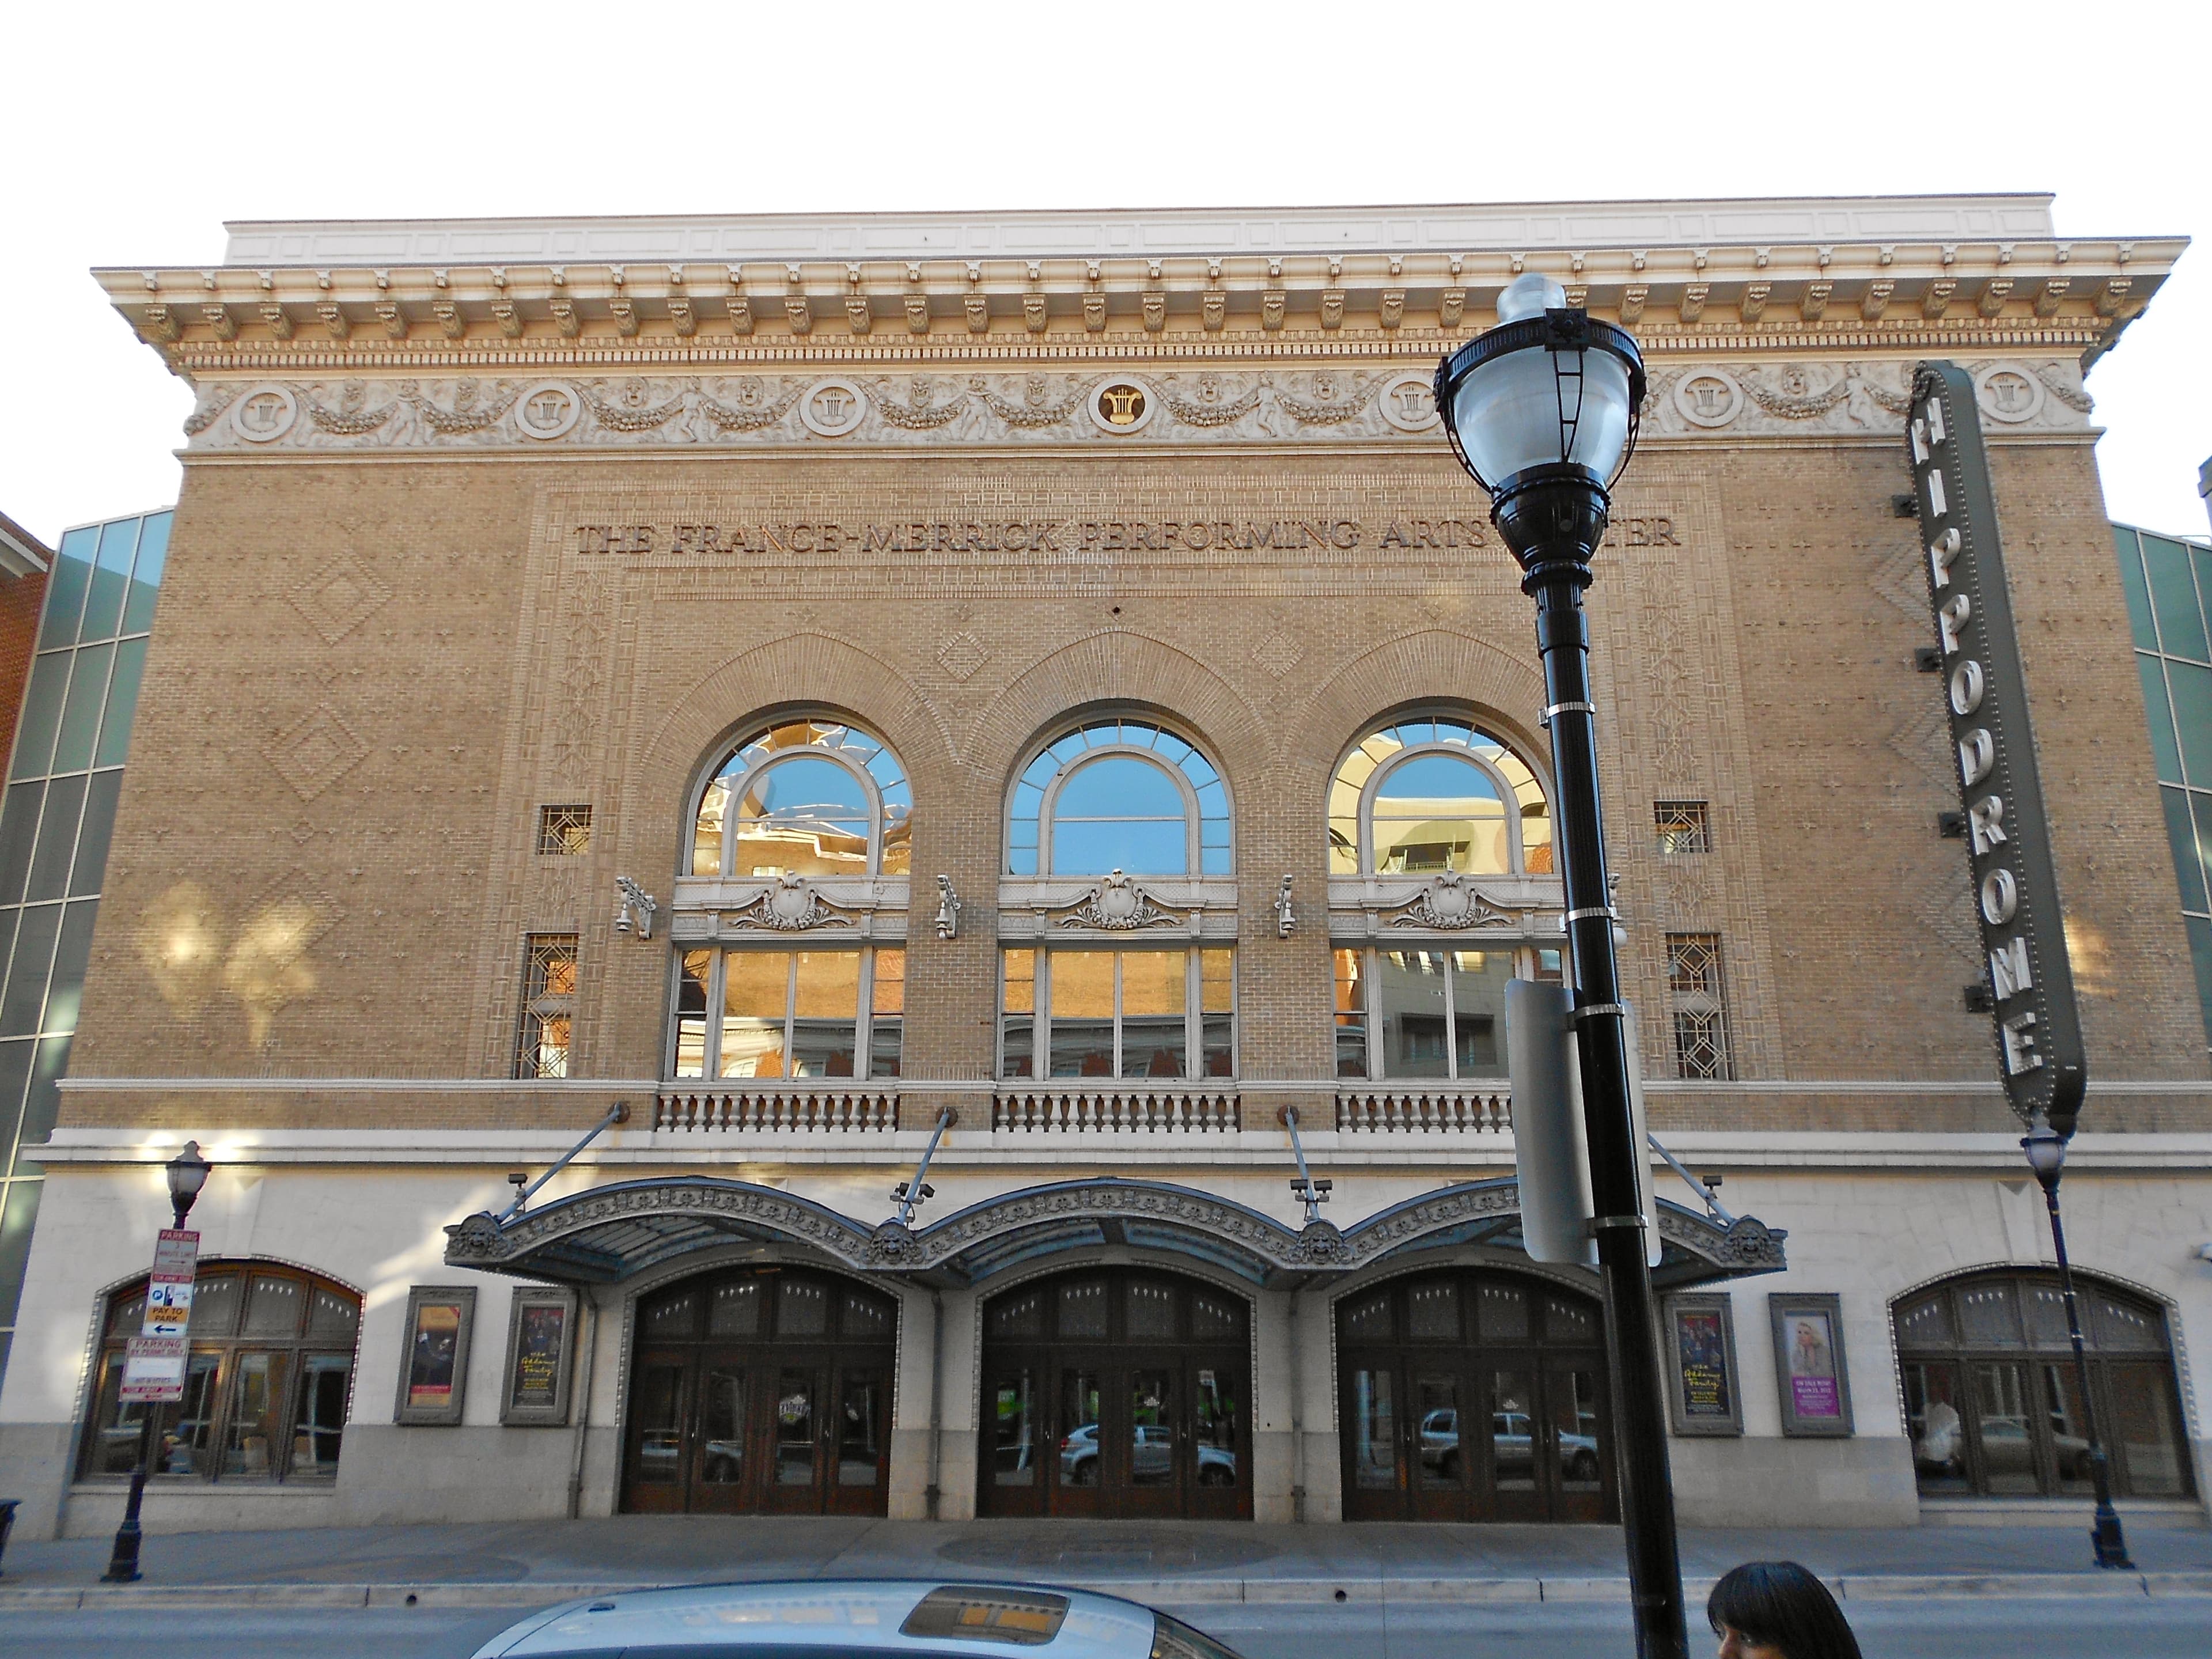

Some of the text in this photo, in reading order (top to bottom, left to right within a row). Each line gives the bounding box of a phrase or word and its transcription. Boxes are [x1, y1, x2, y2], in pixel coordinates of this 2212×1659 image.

[575, 518, 1681, 554] THE FRANCE-MERRICK PERFORMING ARTS TER
[1910, 397, 2043, 1076] HIPPODROME
[161, 1230, 199, 1242] PARKING
[136, 1339, 180, 1348] PARKING
